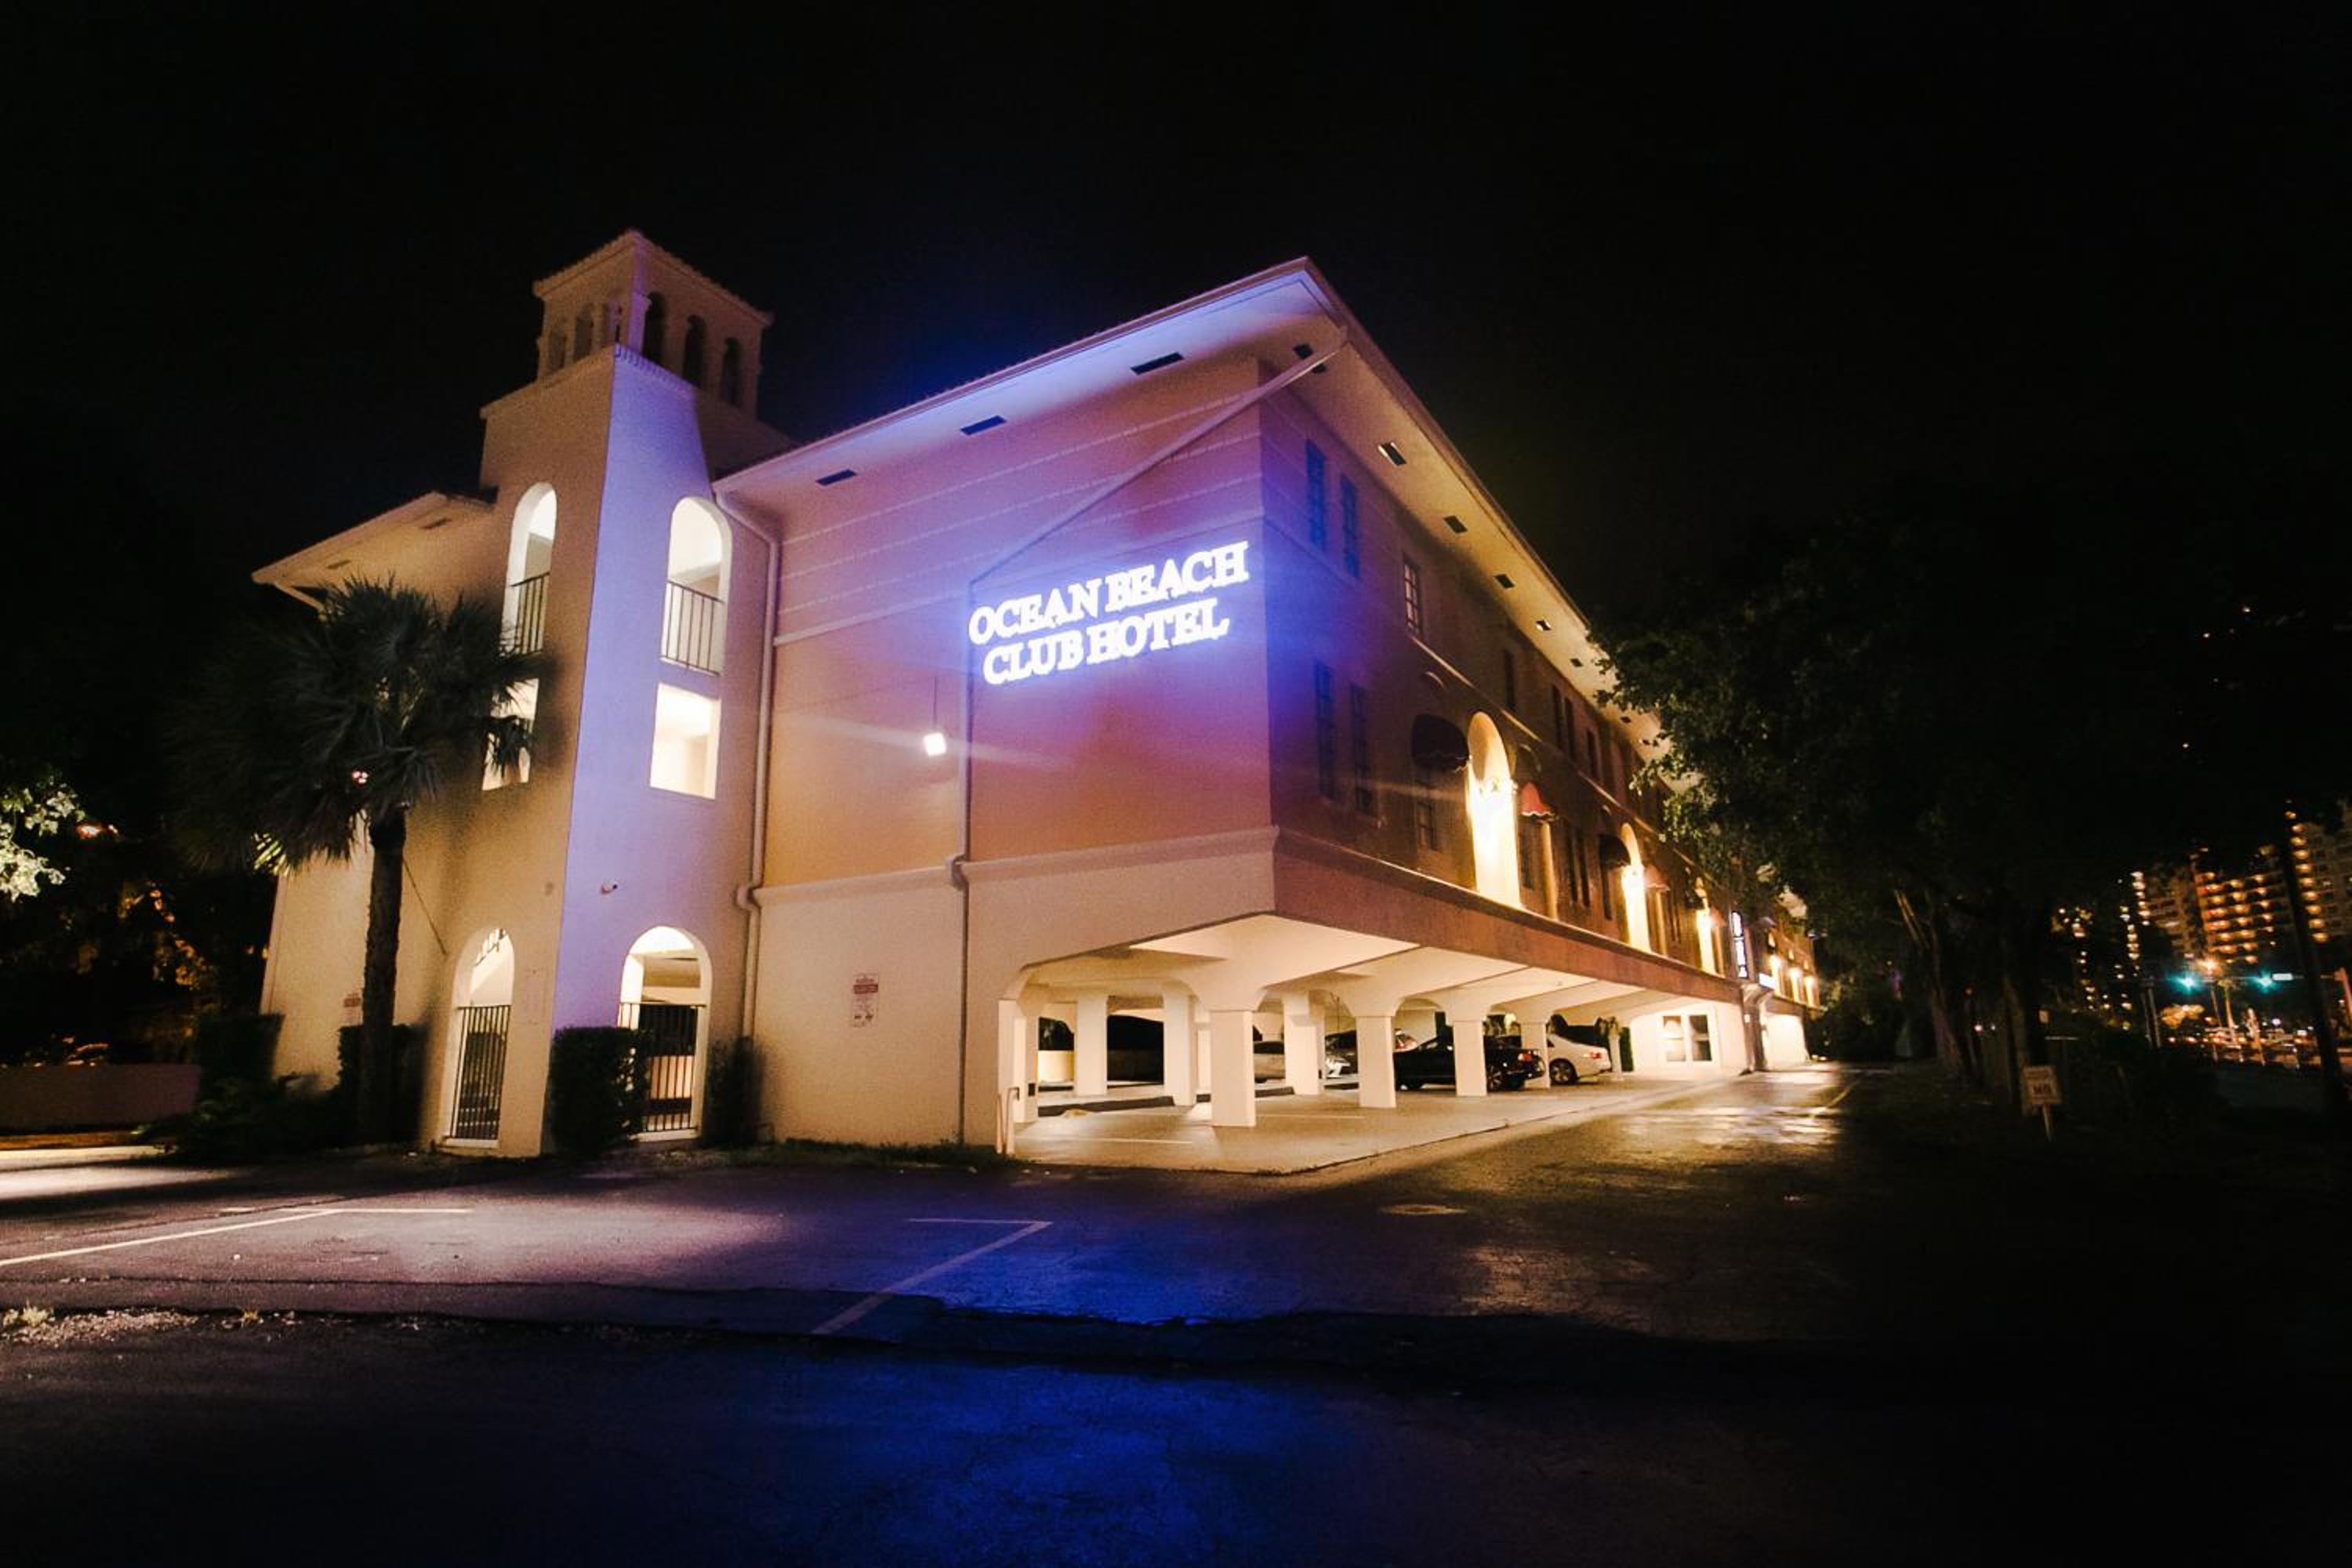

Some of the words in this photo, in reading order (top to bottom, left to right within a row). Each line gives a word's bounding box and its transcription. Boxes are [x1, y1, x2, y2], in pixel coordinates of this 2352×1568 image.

[968, 579, 1102, 644] OCEAN
[1105, 541, 1249, 612] BEACH
[982, 630, 1083, 684] CLUB
[1087, 598, 1230, 665] HOTEL
